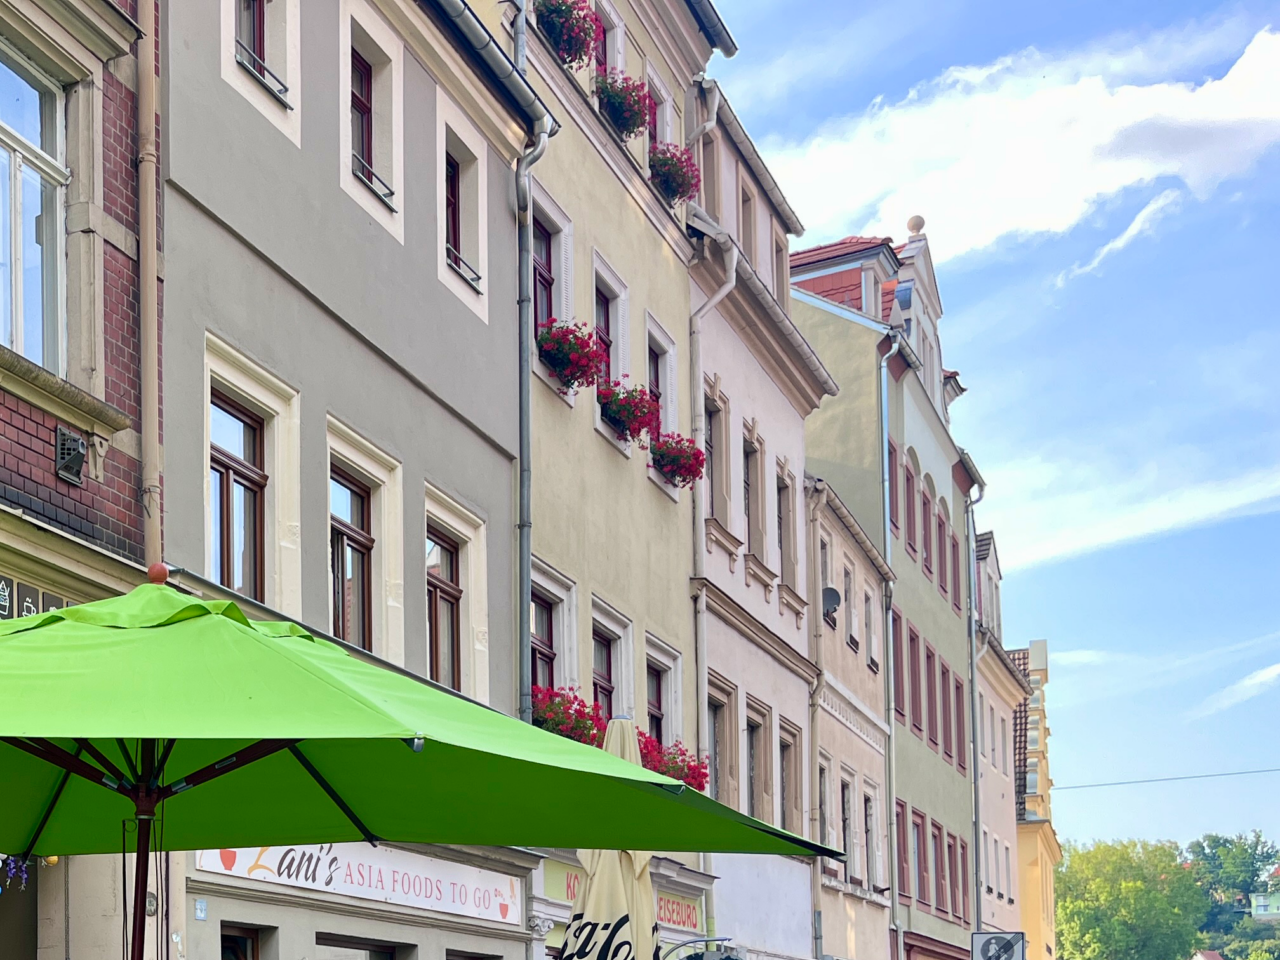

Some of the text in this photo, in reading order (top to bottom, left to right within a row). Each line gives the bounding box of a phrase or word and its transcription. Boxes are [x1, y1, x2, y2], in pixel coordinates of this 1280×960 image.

[344, 861, 385, 890] ASIA
[392, 870, 442, 901] FOODS
[450, 882, 468, 905] TO
[473, 887, 491, 910] GO
